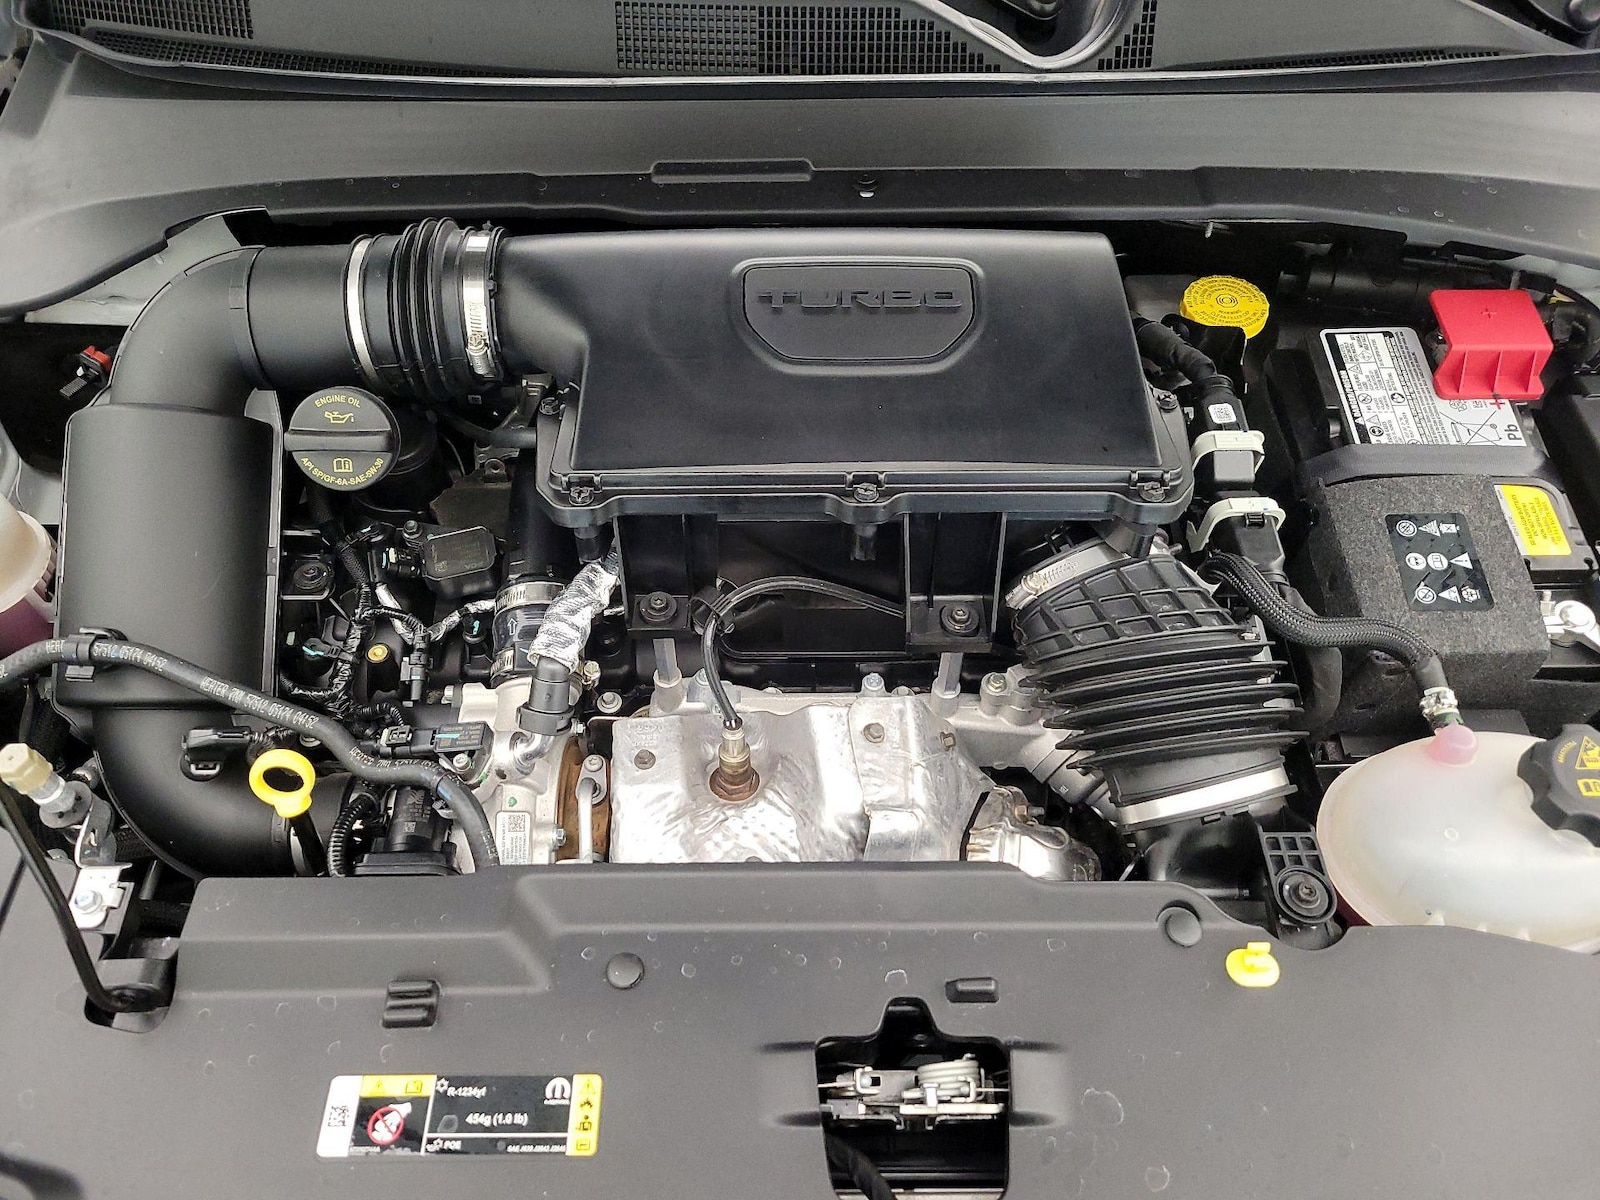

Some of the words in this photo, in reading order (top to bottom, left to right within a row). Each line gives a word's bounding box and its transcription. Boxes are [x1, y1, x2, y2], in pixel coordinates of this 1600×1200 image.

[758, 290, 962, 309] TURBO
[315, 395, 346, 408] ENGINE
[347, 397, 361, 408] OIL
[1339, 370, 1362, 416] DANGER/POISON
[1504, 424, 1522, 441] Pb
[301, 458, 314, 471] API
[199, 676, 229, 698] HEATER
[465, 1112, 492, 1128] 454g
